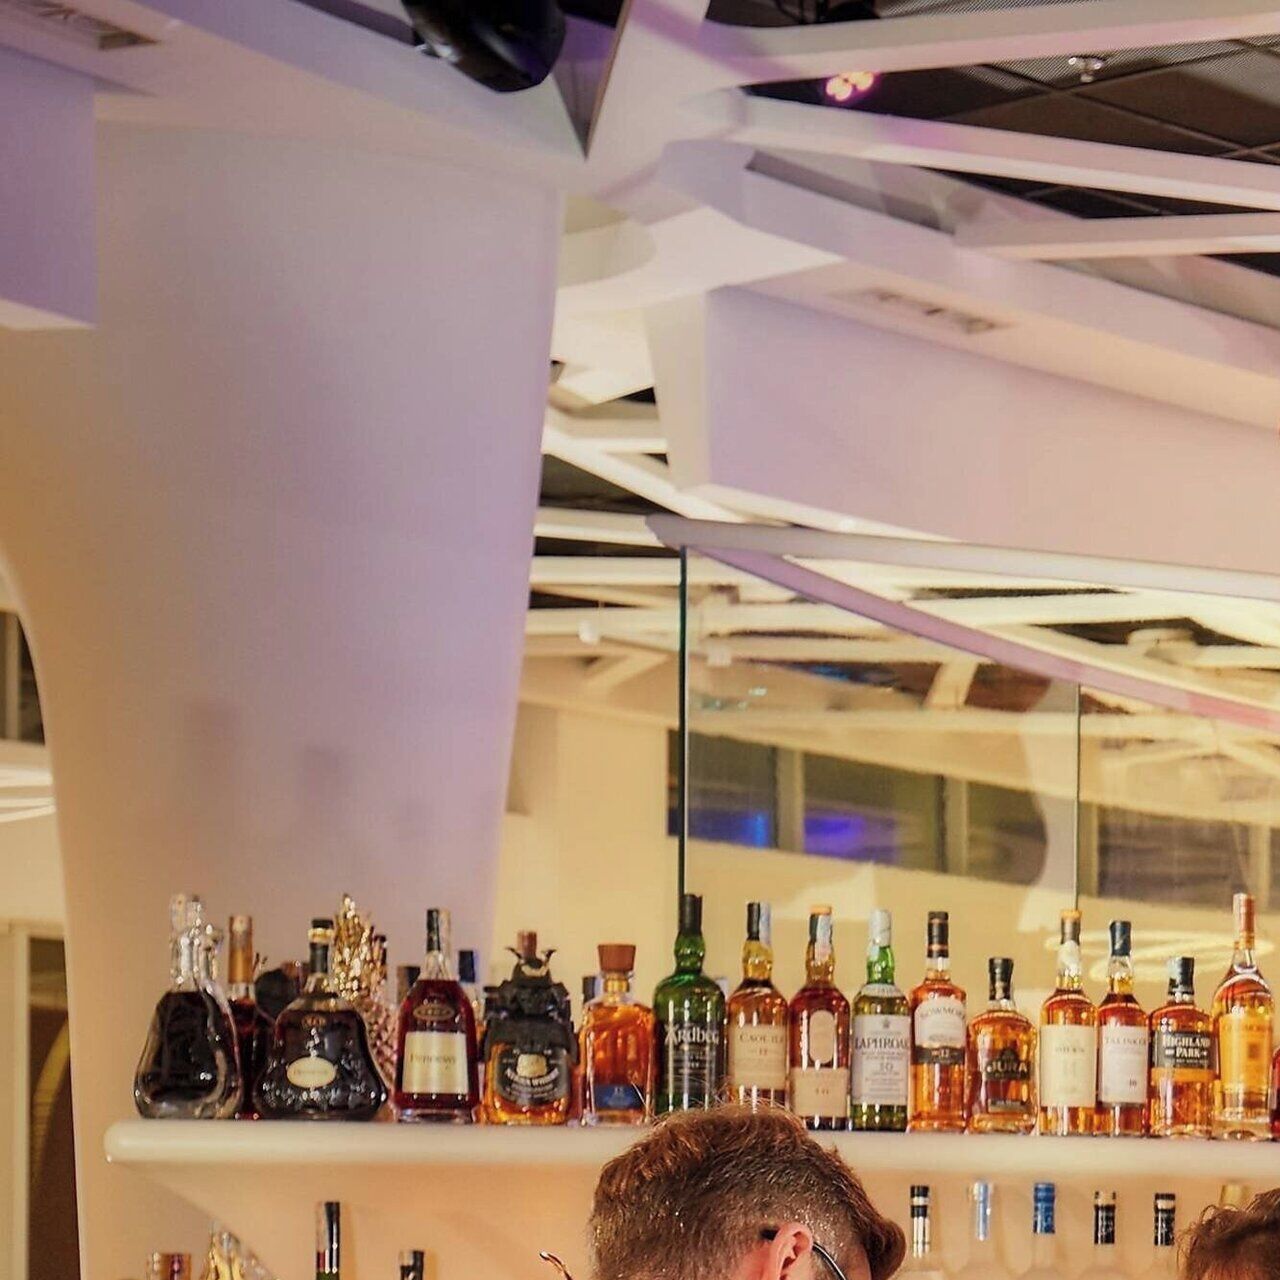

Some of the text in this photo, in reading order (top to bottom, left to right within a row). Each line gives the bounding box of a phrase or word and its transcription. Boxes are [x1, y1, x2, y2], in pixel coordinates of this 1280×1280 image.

[1162, 1034, 1211, 1047] HIGHLAND
[1175, 1047, 1202, 1058] PARK
[989, 1060, 1028, 1073] JURA
